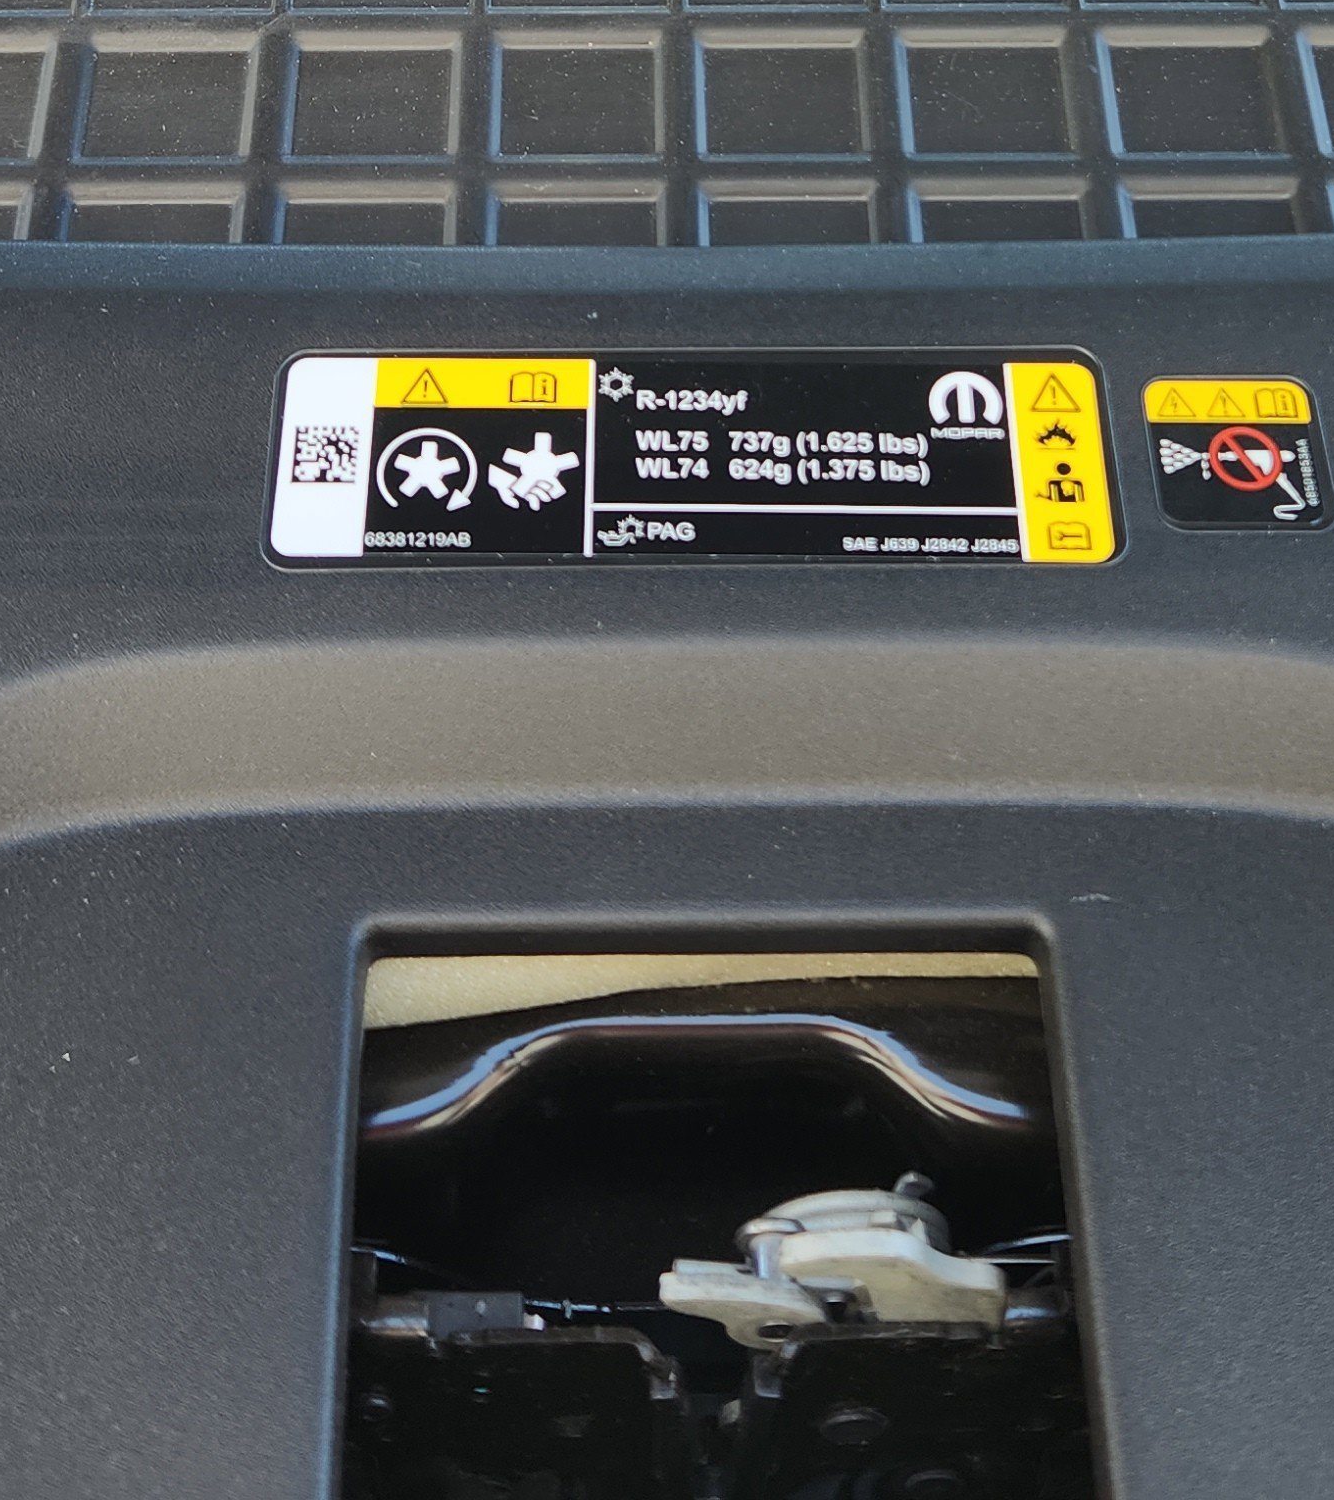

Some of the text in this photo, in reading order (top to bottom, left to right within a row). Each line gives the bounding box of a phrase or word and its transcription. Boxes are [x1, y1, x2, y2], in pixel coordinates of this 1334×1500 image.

[635, 389, 749, 416] R-1234yf
[930, 426, 1005, 440] MOPAR
[635, 430, 929, 459] WL75 737g (1.625 lbs)
[635, 457, 931, 487] WL74 624g (1.375 lbs)
[364, 531, 472, 548] 68381219AB
[647, 521, 697, 542] PAG
[842, 536, 1019, 554] SAE J639 J2842 J2845
